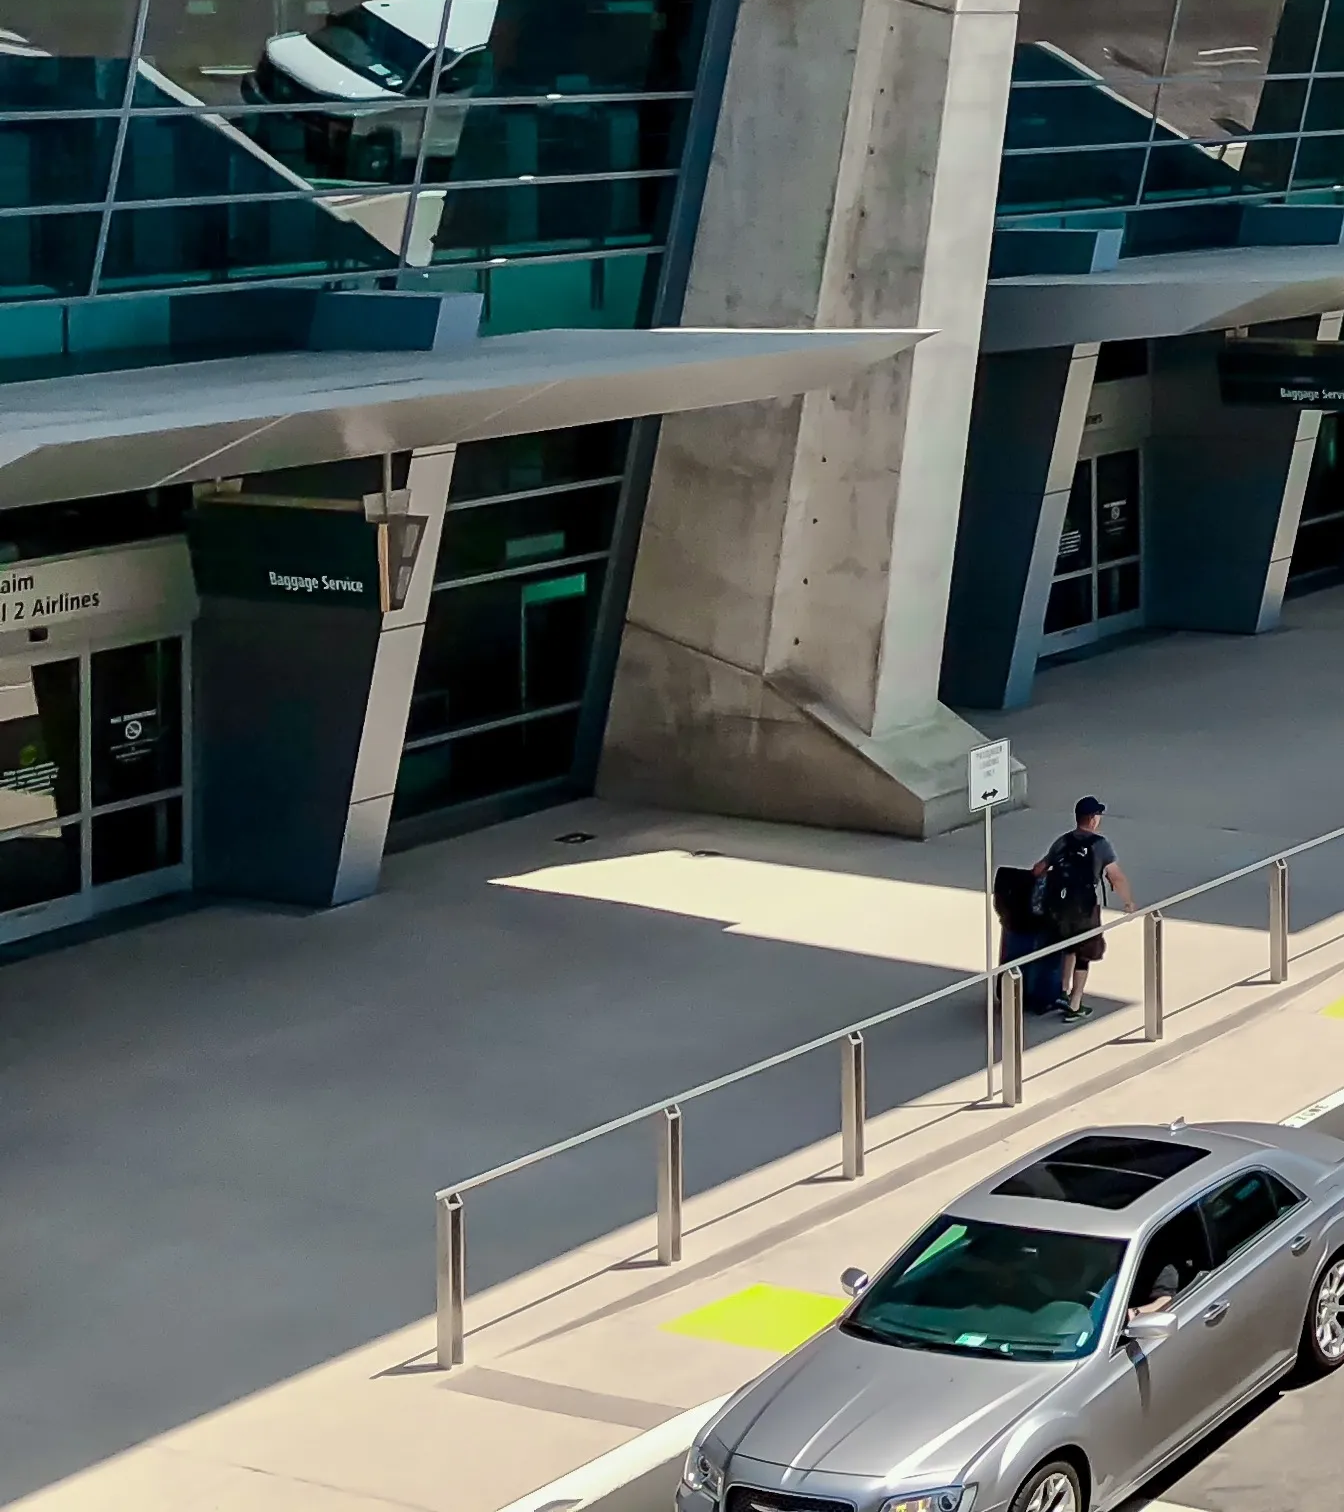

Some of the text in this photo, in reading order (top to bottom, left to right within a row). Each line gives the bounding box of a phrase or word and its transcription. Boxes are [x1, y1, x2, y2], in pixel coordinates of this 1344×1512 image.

[268, 571, 364, 593] Baggage Service
[14, 601, 25, 620] 2
[31, 591, 101, 618] Airlines
